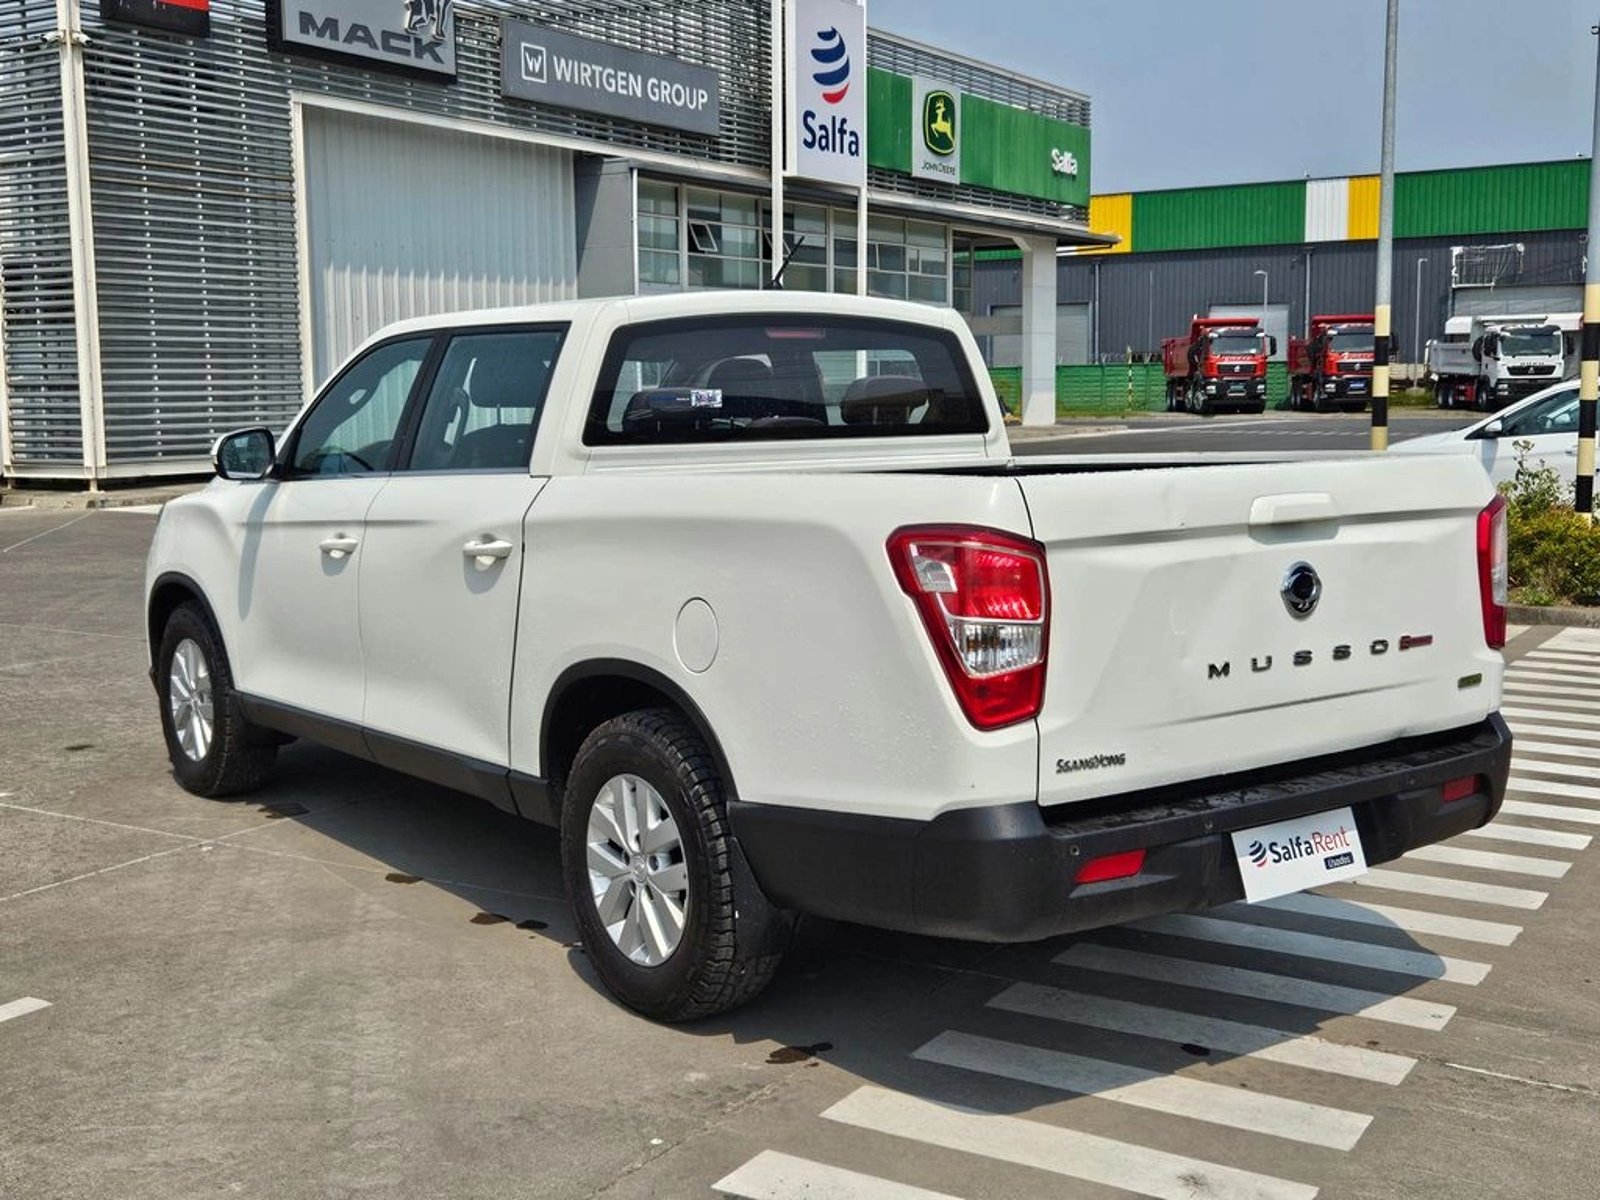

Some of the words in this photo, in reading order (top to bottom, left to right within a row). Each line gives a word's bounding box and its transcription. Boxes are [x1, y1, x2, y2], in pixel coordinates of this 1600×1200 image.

[298, 11, 445, 64] MACK
[553, 55, 642, 98] WIRTGEN
[647, 77, 708, 110] GROUP
[802, 110, 859, 157] Salfa
[1051, 148, 1078, 175] Salfa
[1208, 639, 1389, 679] MUSSO
[1268, 826, 1350, 863] SalfaRent
